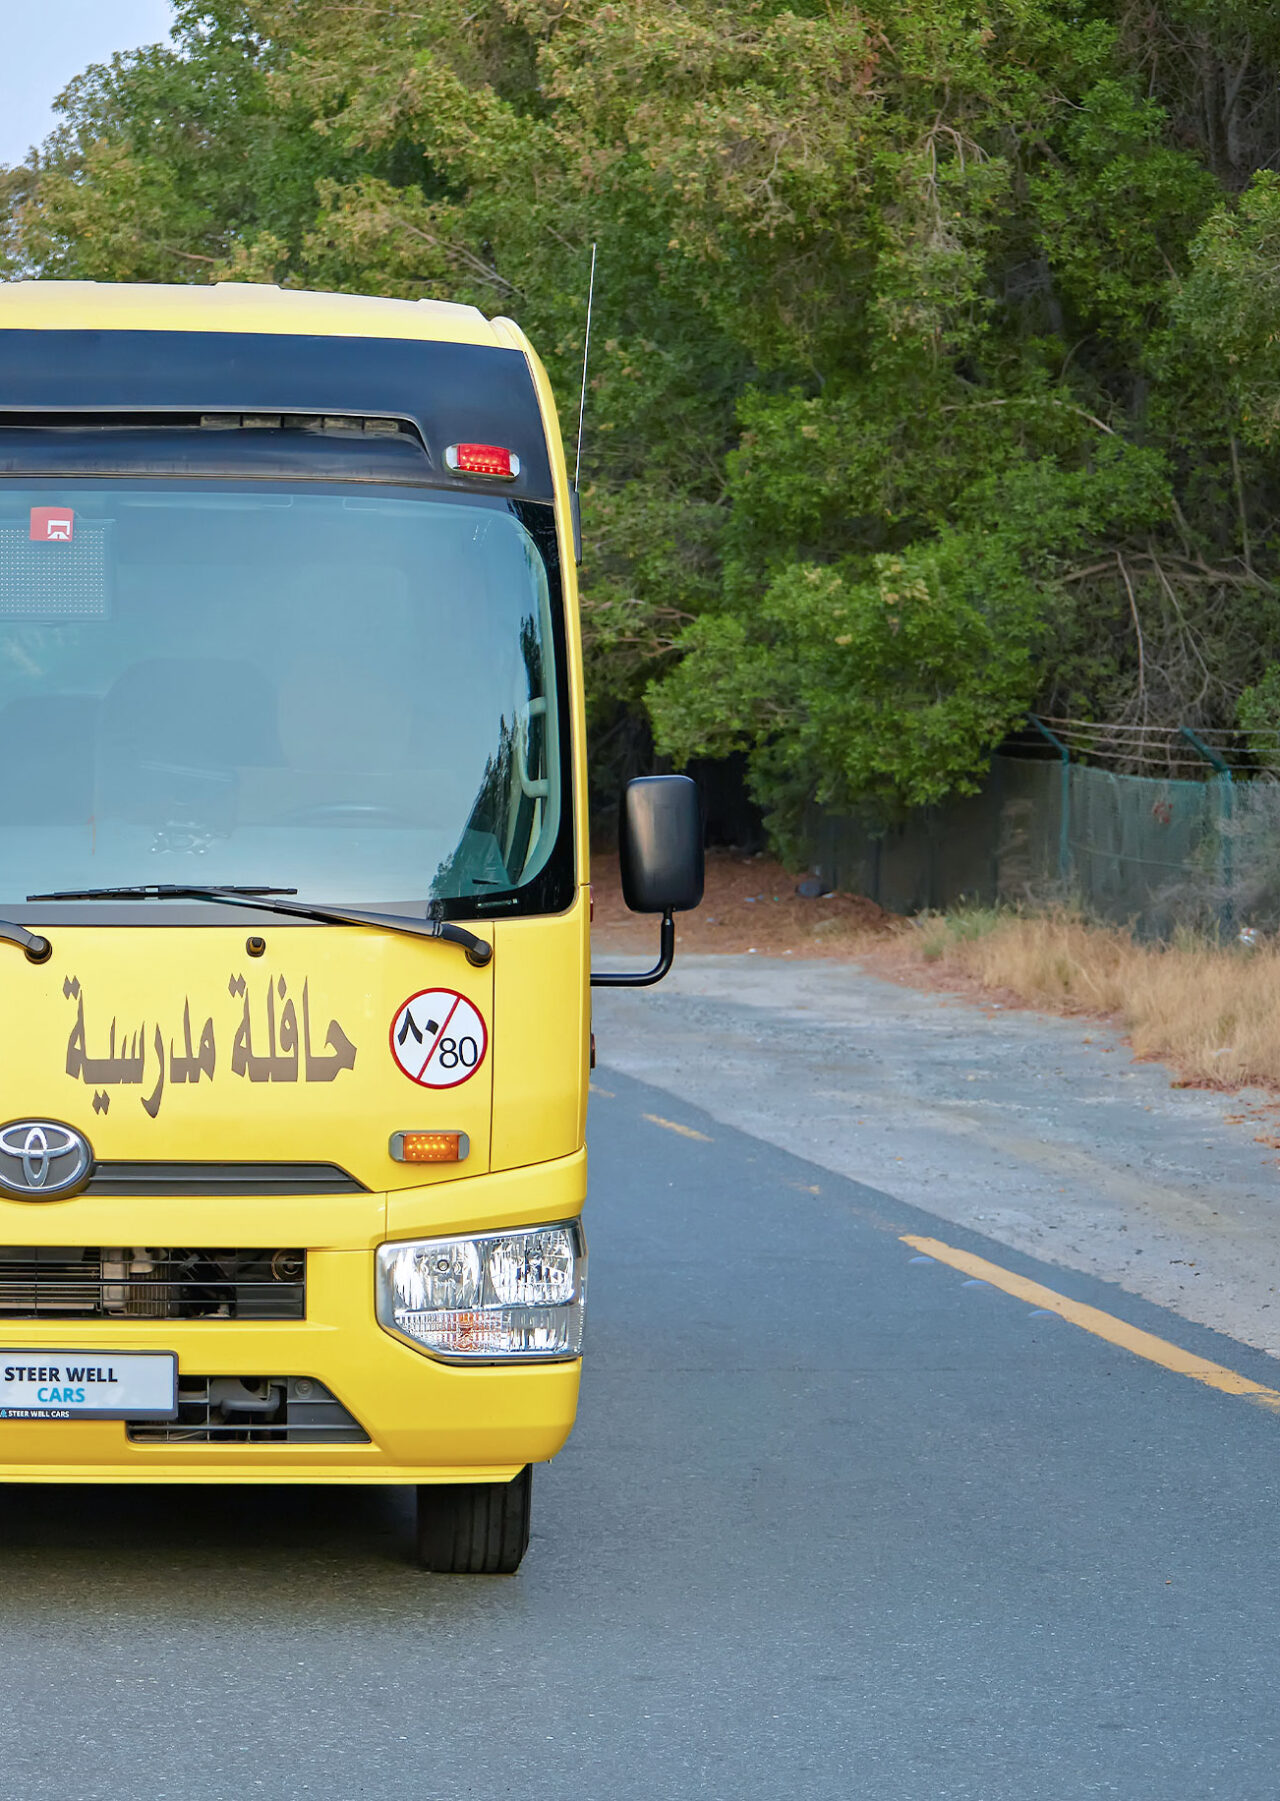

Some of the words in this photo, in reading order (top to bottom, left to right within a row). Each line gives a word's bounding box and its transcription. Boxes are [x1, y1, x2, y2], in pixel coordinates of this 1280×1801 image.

[228, 972, 357, 1083] حافلة
[397, 1007, 439, 1046] ٨٠
[62, 973, 216, 1119] مدرسية
[438, 1036, 478, 1069] 80
[4, 1367, 61, 1382] STEER
[66, 1367, 118, 1383] WELL
[37, 1387, 85, 1403] CARS
